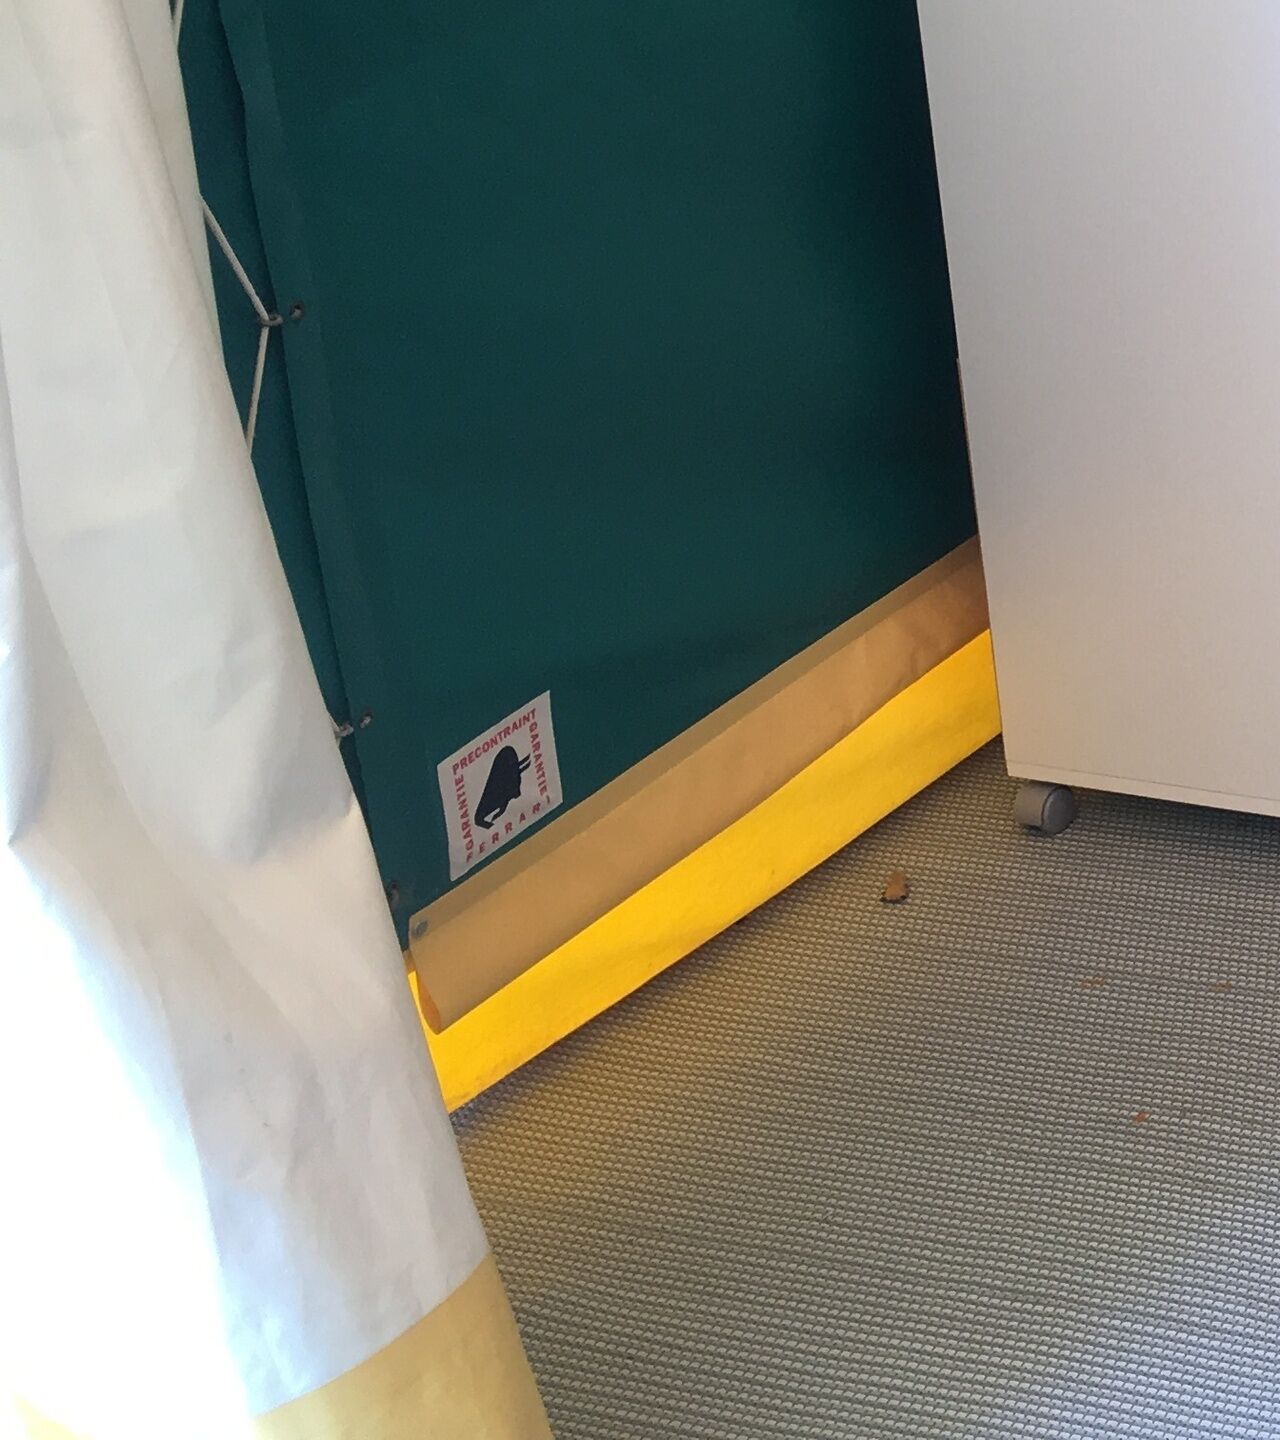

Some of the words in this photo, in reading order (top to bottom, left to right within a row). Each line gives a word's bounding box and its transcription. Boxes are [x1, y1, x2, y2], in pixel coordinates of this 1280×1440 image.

[452, 708, 536, 775] PRECONTRAINT
[529, 722, 548, 797] GARANTIE
[455, 773, 474, 852] GARANTIE
